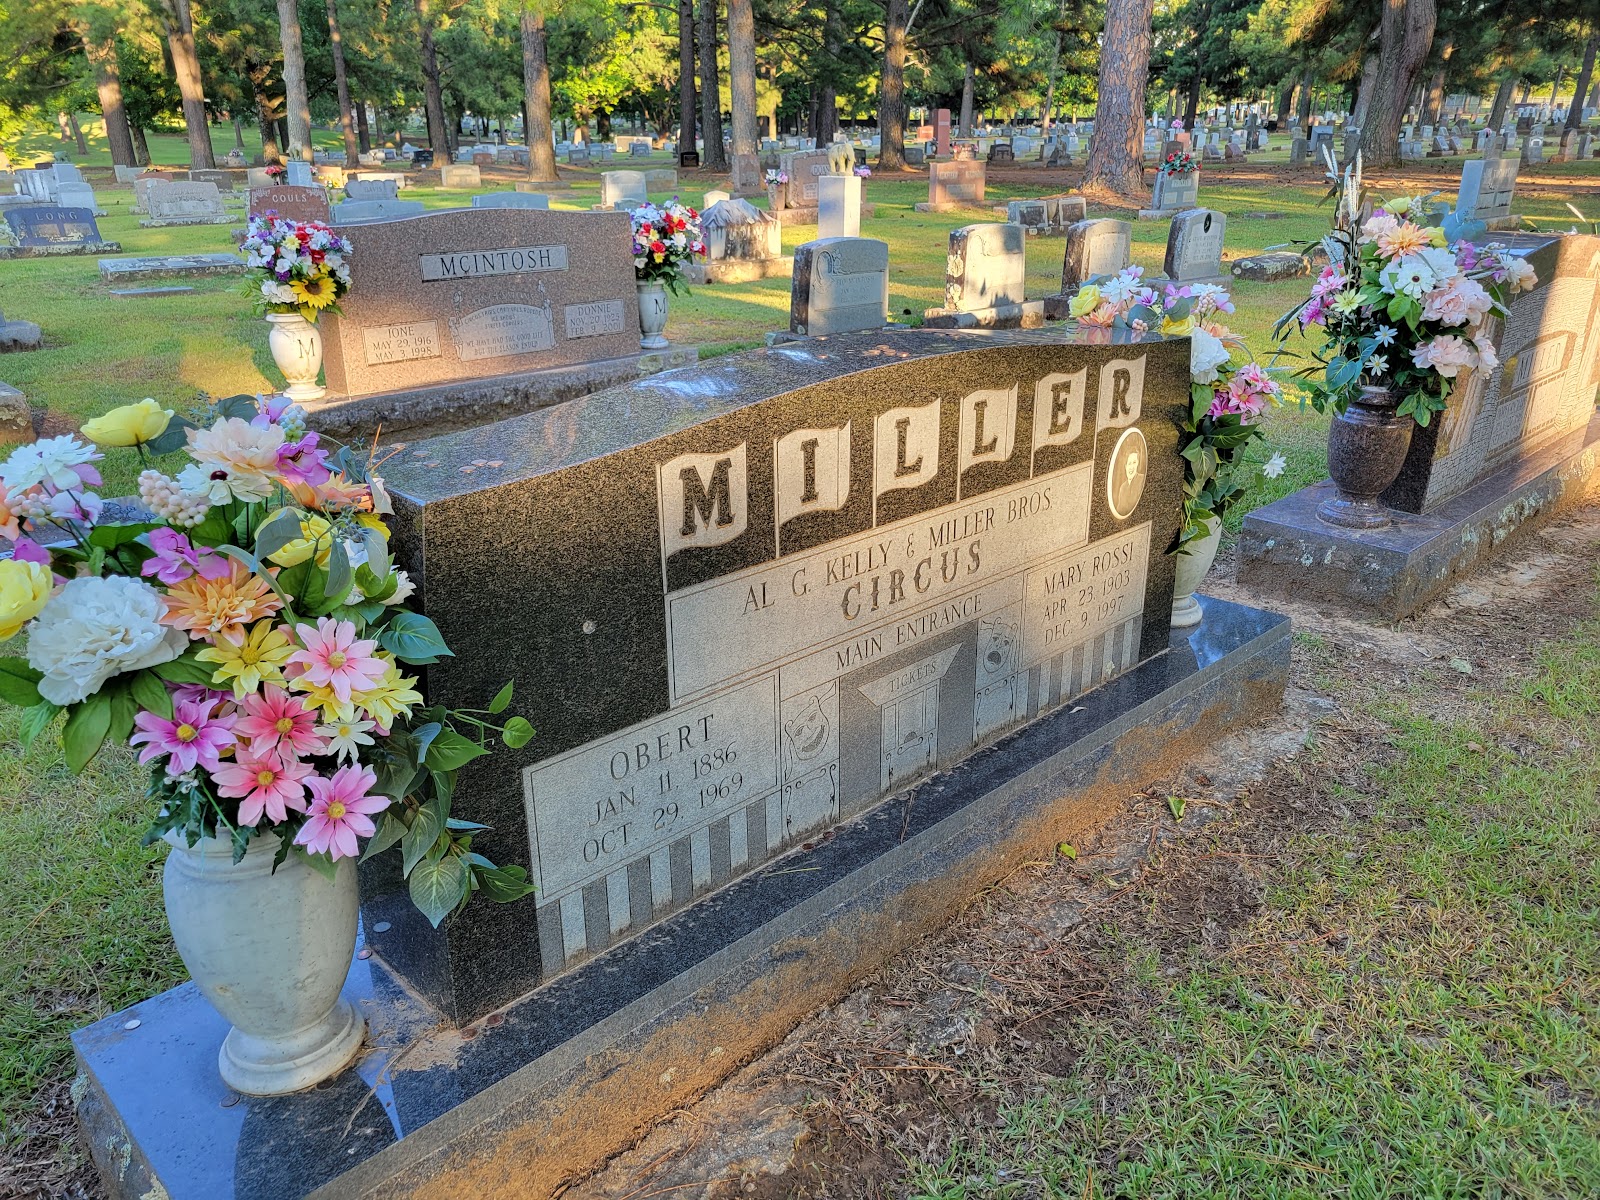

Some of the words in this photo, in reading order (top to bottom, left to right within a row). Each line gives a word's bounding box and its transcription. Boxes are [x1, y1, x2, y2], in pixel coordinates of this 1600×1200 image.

[272, 194, 307, 203] COULS
[35, 211, 78, 221] LONG
[440, 249, 552, 276] MCINTOSH
[577, 303, 611, 317] DONNIE
[603, 312, 620, 323] 1925
[654, 297, 667, 315] M
[388, 326, 415, 338] IONE
[603, 322, 621, 332] 2001
[297, 337, 315, 358] M
[372, 340, 392, 351] MAY
[414, 336, 432, 346] 1916
[375, 350, 395, 361] MAY
[411, 346, 432, 357] 1998
[679, 366, 1132, 537] MILLER
[741, 580, 775, 617] AL
[791, 566, 811, 597] G.
[824, 539, 892, 587] KELLY
[906, 532, 915, 559] &
[928, 507, 996, 551] MILLER
[1043, 560, 1087, 597] MARY
[1092, 542, 1134, 577] ROSSI
[840, 539, 982, 621] CIRCUS
[1102, 569, 1130, 597] 1903
[1097, 595, 1125, 621] 1997
[835, 632, 885, 671] MAIN
[896, 592, 982, 646] ENTRANCE
[886, 660, 937, 692] TICKETS
[609, 713, 714, 780] OBERT
[692, 741, 738, 780] 1886
[699, 772, 743, 809] 1969
